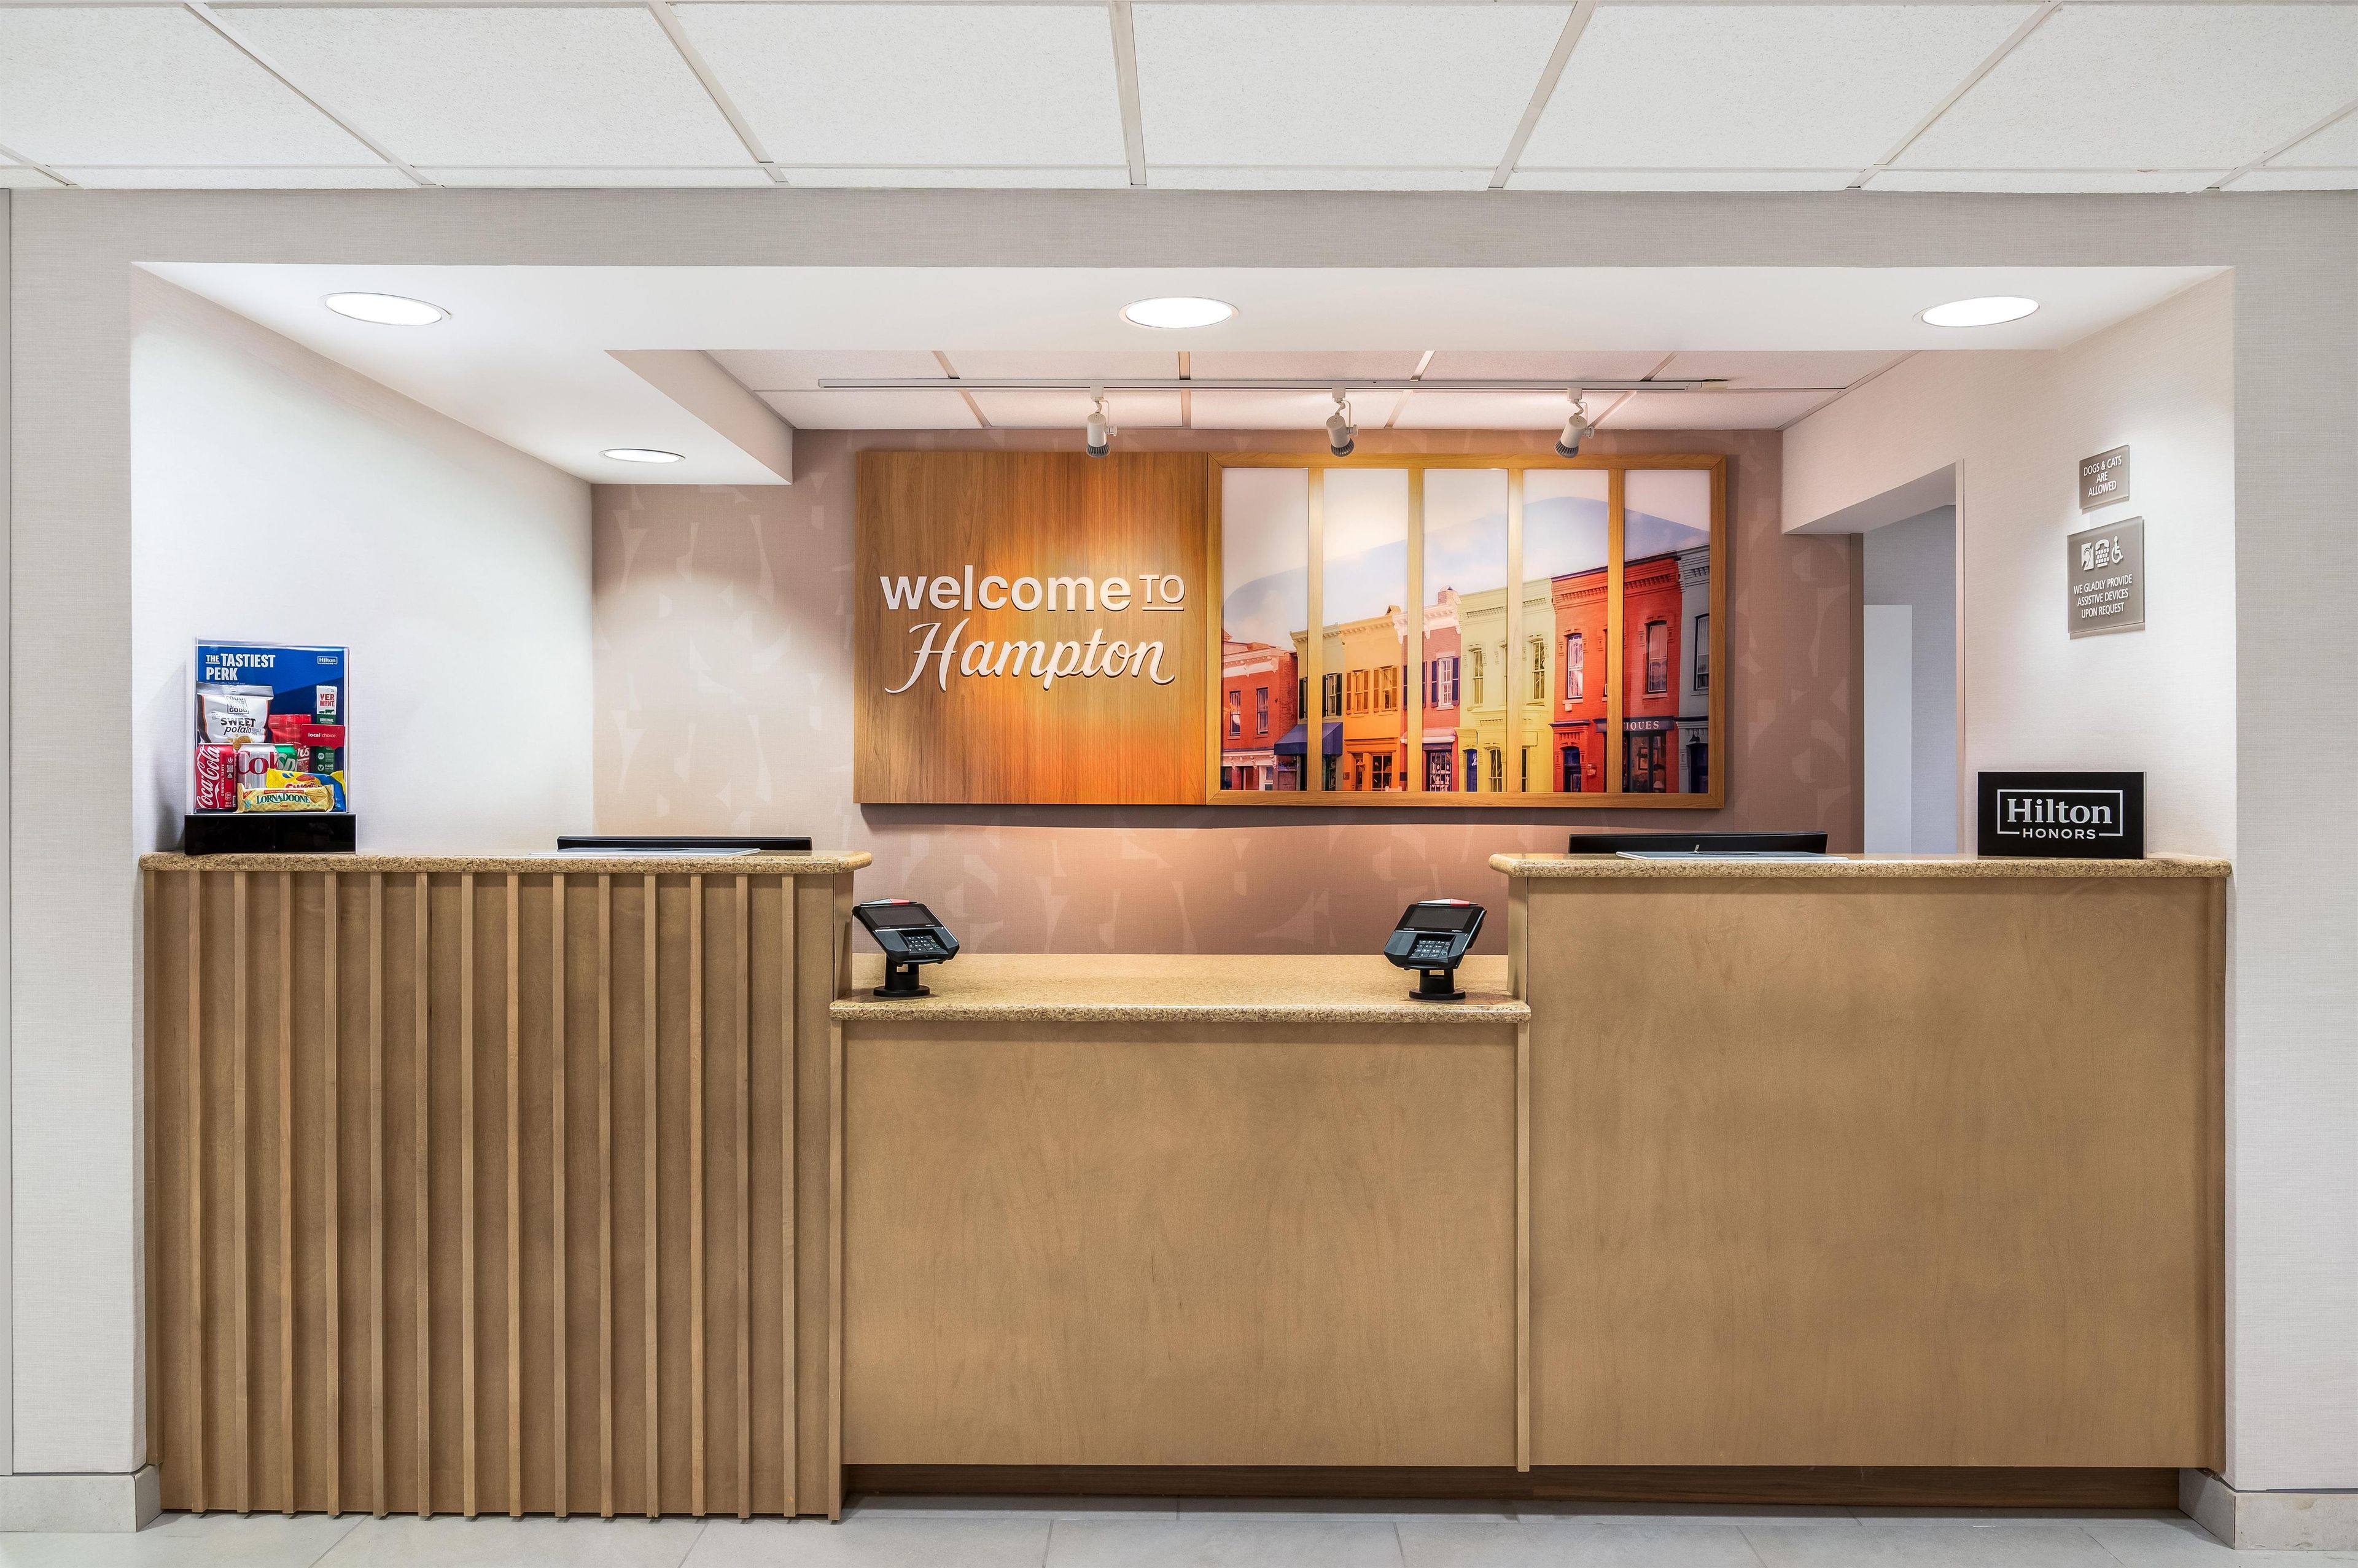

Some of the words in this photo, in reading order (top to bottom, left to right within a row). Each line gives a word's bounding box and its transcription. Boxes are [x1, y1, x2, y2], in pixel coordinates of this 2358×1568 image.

[2084, 462, 2100, 476] DOGS
[2101, 460, 2106, 471] &
[2107, 455, 2122, 468] CATS
[2096, 471, 2108, 484] ARE
[2088, 480, 2117, 497] ALLOWED
[880, 565, 1131, 611] welcome
[1139, 573, 1185, 605] TO
[2073, 584, 2083, 595] WE
[2084, 579, 2106, 592] GLADLY
[2107, 573, 2133, 588] PROVIDE
[2077, 593, 2104, 607] ASSISTIVE
[2104, 588, 2129, 602] DEVICES
[2081, 607, 2098, 618] UPON
[2099, 602, 2125, 615] REQUEST
[220, 653, 276, 668] TASTIEST
[885, 618, 1175, 694] Hampton
[206, 667, 238, 681] PERK
[220, 718, 256, 728] SWEET
[224, 725, 252, 735] potato
[1623, 720, 1660, 731] IQUES
[236, 750, 278, 775] Cok
[2007, 798, 2112, 824] Hilton
[2023, 828, 2096, 839] HONORS
